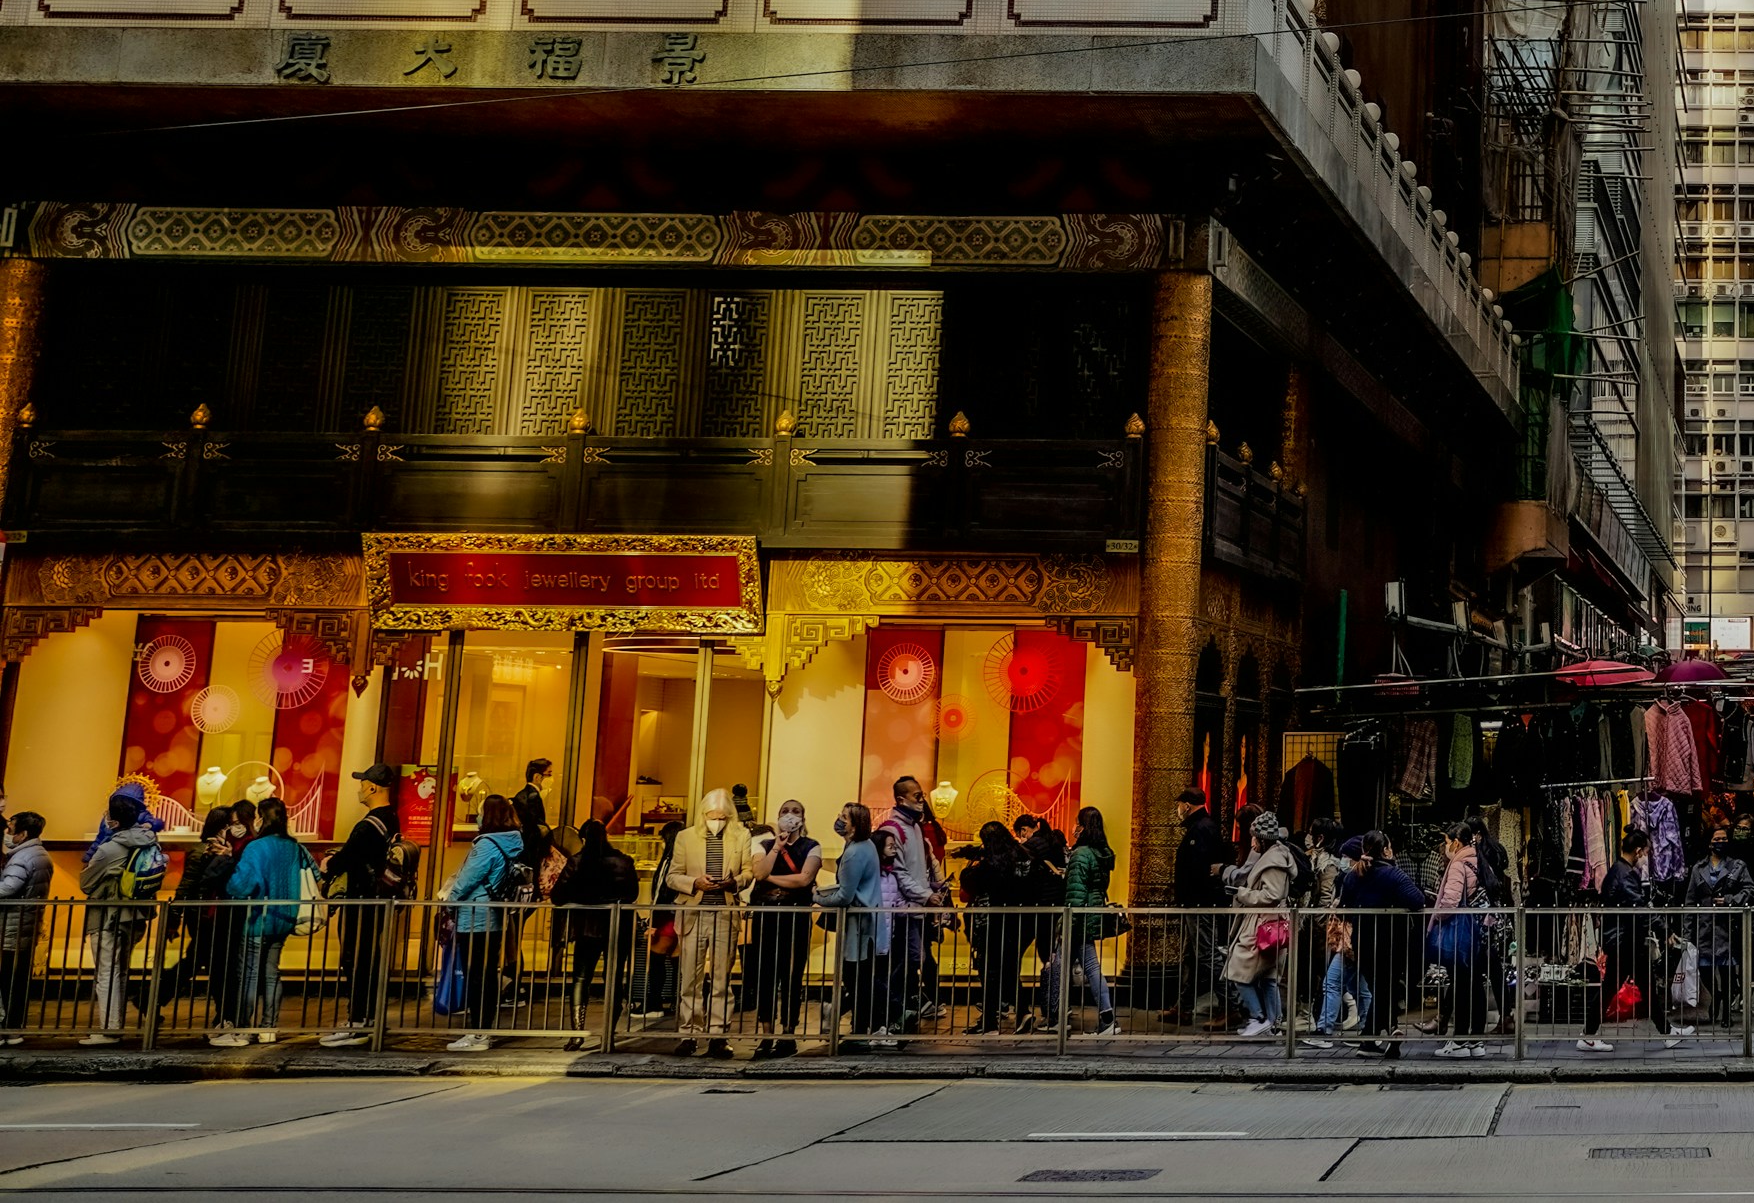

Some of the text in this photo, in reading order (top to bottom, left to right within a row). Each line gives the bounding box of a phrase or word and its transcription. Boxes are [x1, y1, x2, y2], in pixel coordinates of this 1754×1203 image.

[408, 561, 449, 592] king
[464, 561, 508, 589] fook
[524, 569, 610, 592] jewellery
[626, 573, 680, 594] group
